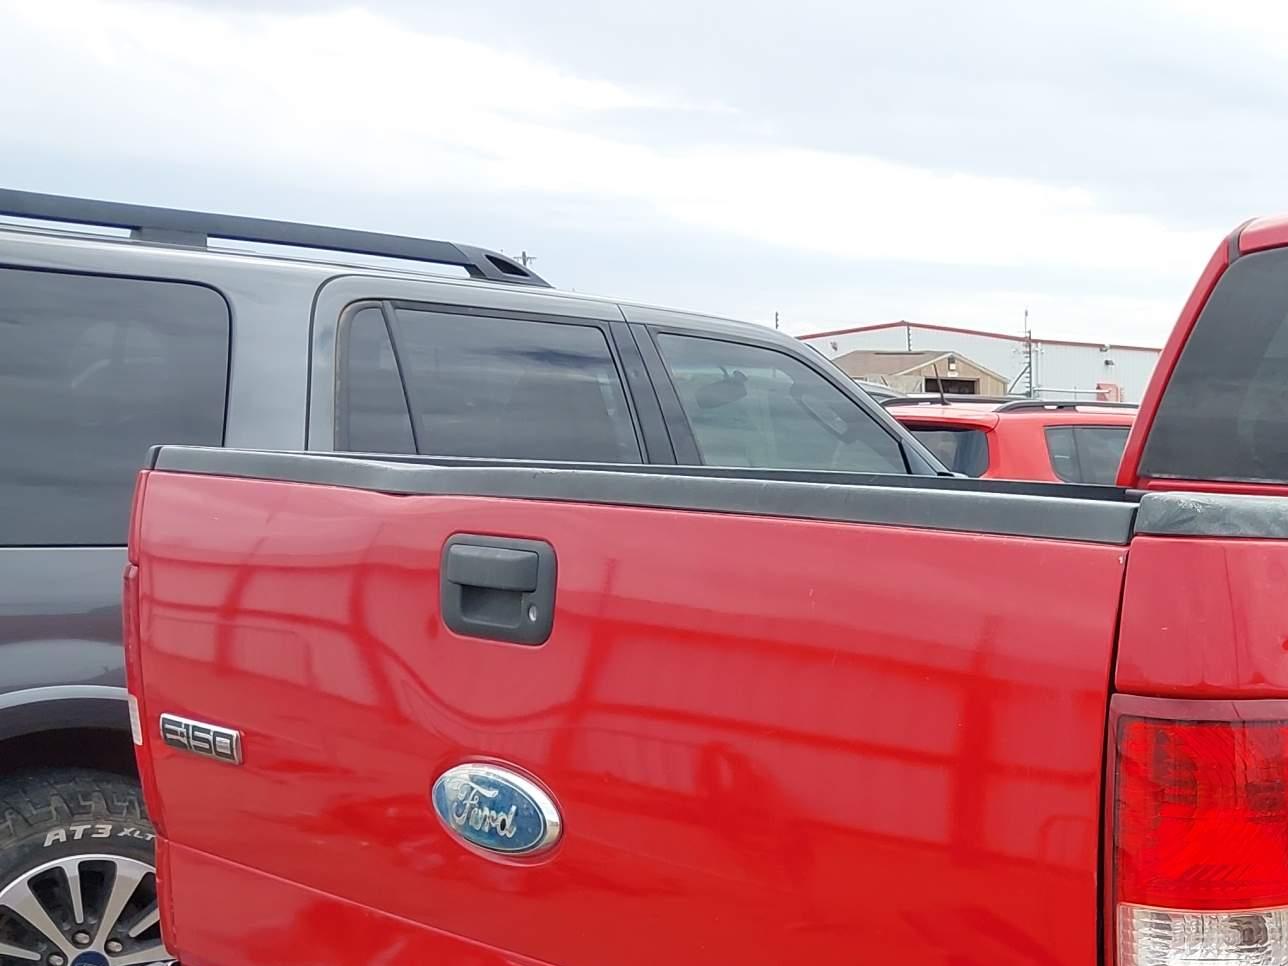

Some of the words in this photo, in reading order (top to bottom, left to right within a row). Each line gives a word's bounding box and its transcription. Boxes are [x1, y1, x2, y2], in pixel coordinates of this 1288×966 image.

[452, 780, 517, 838] Ford
[43, 824, 113, 847] AT3
[117, 827, 155, 841] XLT
